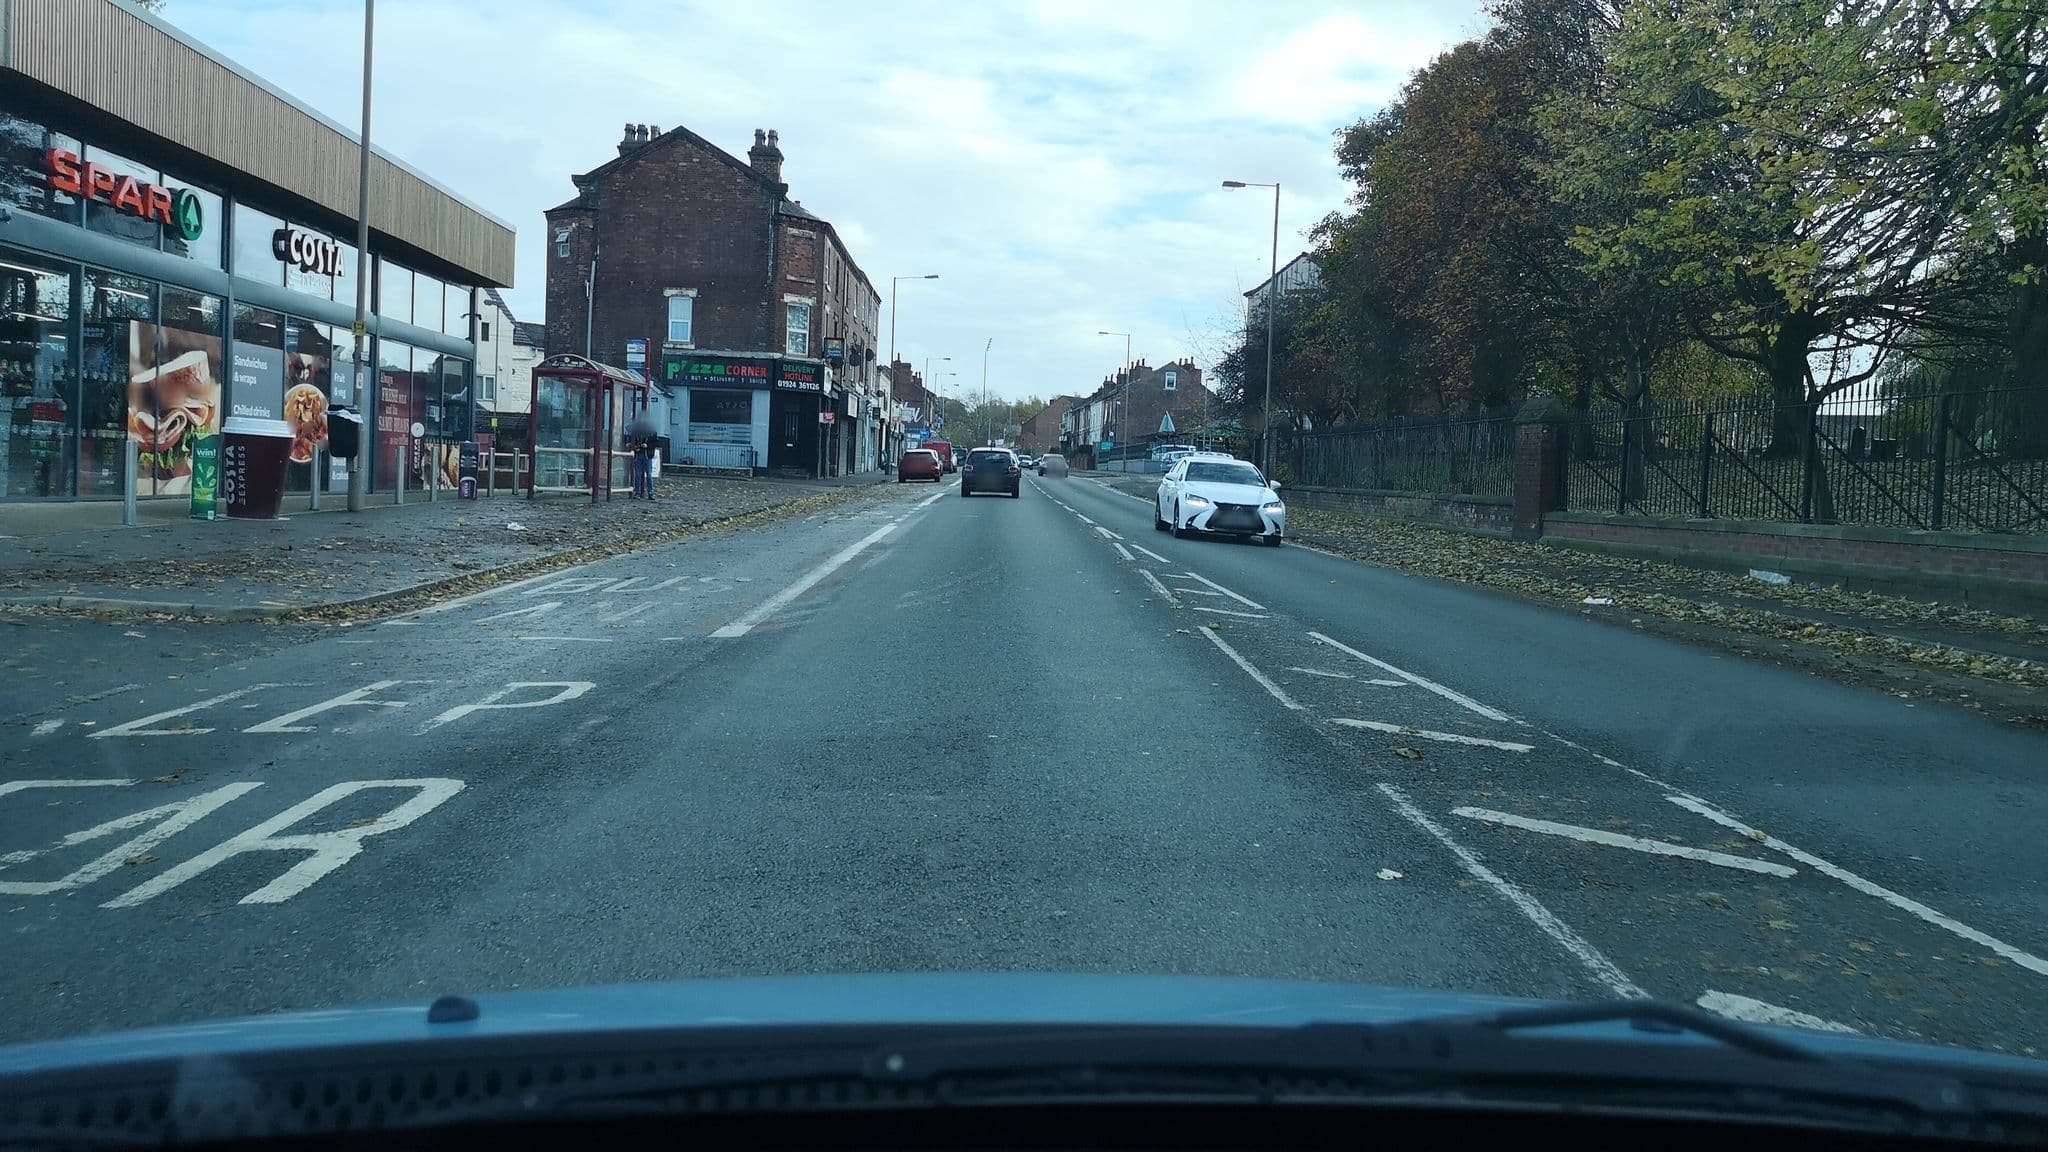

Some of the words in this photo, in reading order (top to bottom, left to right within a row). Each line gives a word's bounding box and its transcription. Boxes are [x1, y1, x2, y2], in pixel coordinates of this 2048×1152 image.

[46, 148, 171, 224] SPAR
[289, 230, 345, 277] COSTA
[234, 355, 267, 370] Sandwiches
[783, 364, 816, 375] DELIVERY
[726, 364, 768, 378] CORNER
[784, 372, 815, 382] HOTLINE
[239, 374, 257, 386] wraps
[777, 379, 797, 389] 01924
[234, 404, 253, 416] Chilled
[254, 406, 271, 417] drinks
[226, 445, 236, 505] COSTA
[238, 445, 246, 496] EXPRESS
